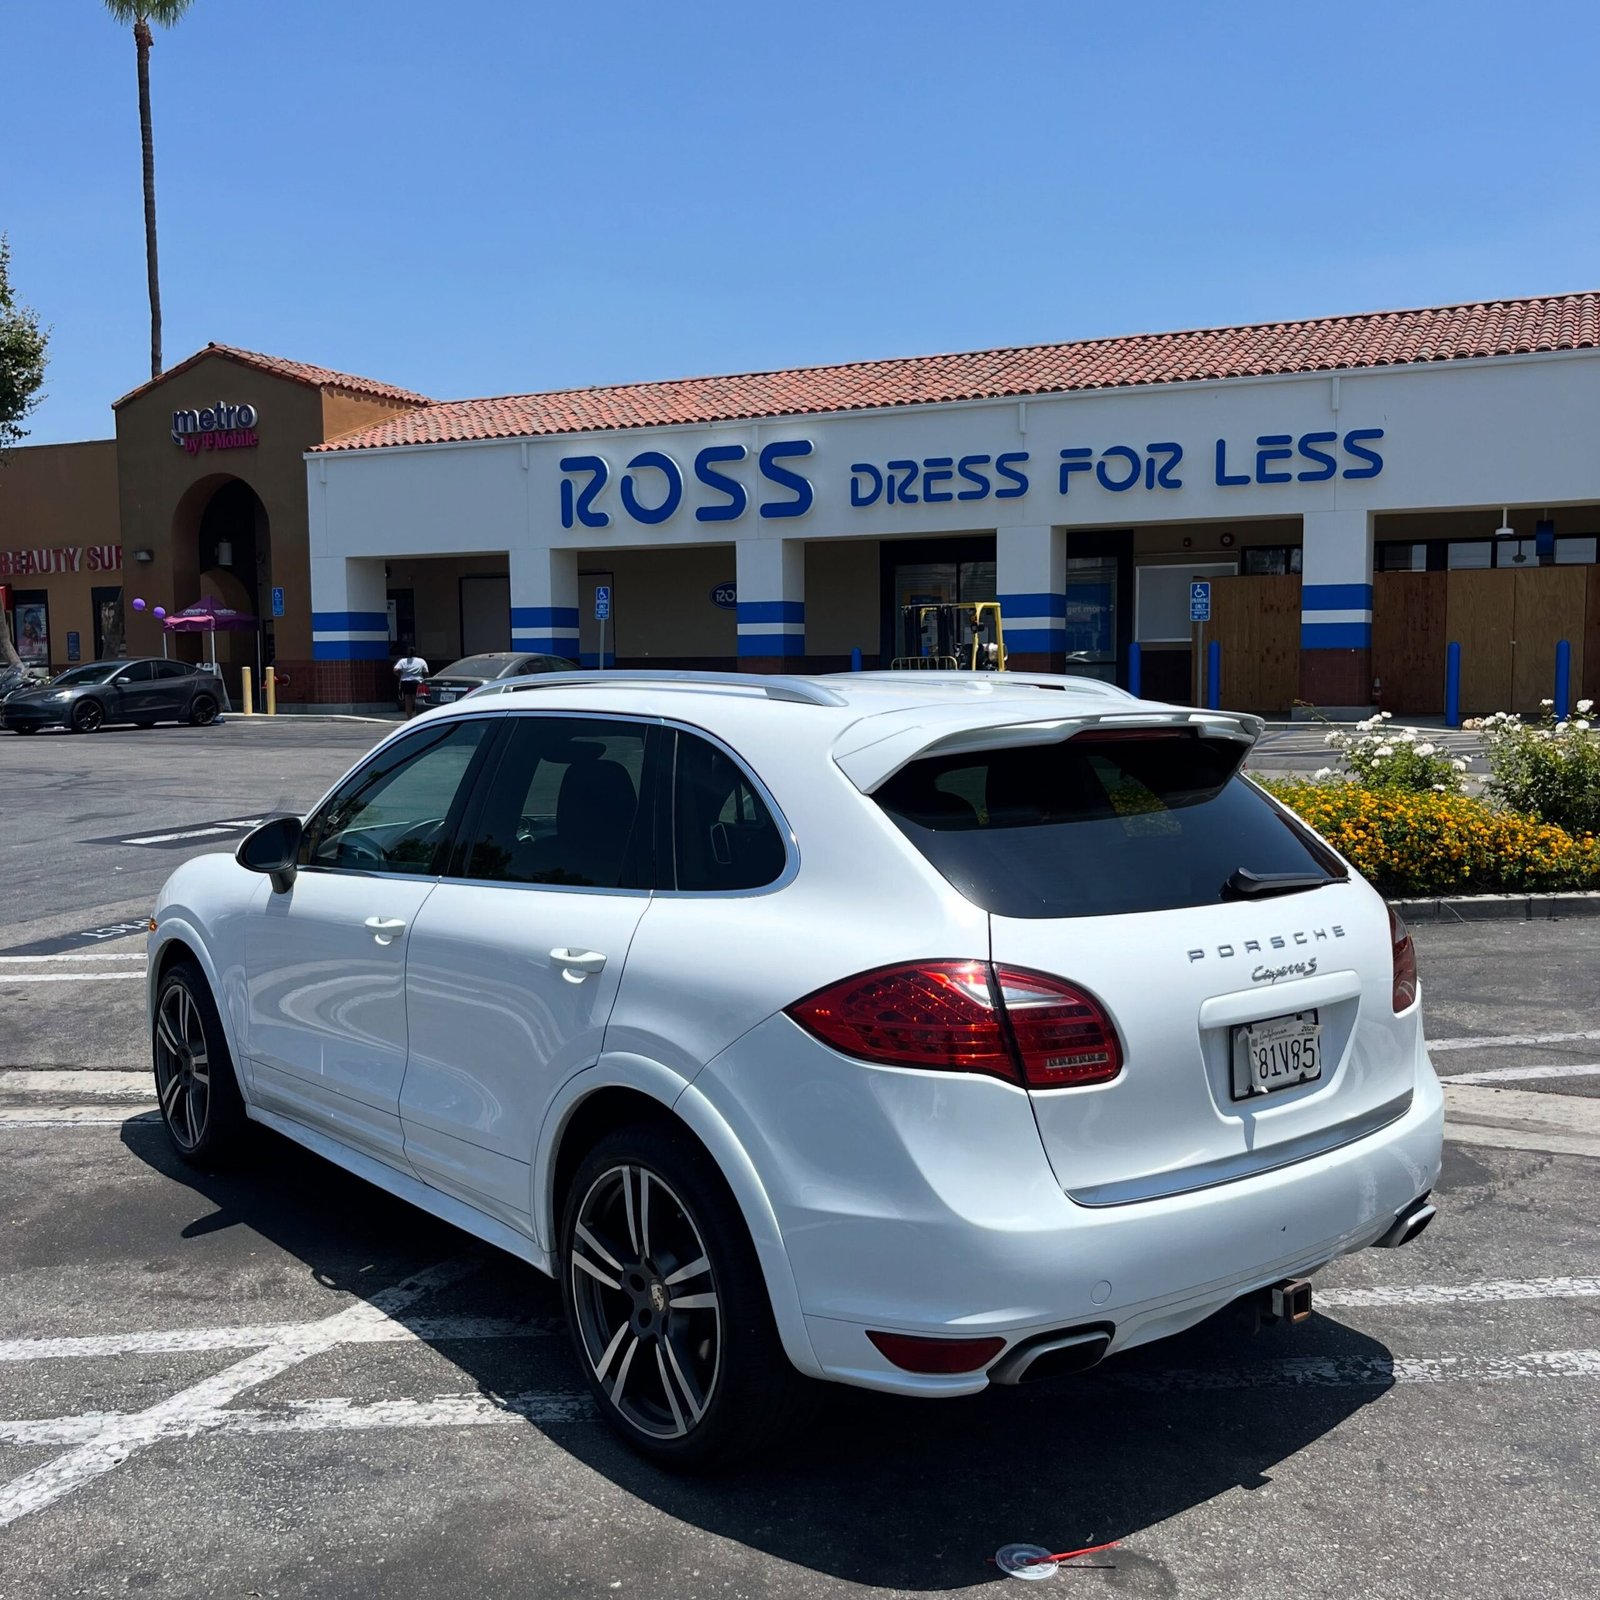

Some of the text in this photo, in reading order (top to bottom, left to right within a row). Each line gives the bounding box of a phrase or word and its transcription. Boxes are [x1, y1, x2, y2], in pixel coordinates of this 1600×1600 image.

[172, 400, 258, 432] metro
[184, 434, 200, 456] by
[560, 428, 1385, 529] ROSS DRESS FOR LESS
[0, 547, 83, 576] BEAUTY
[1187, 925, 1346, 963] PORSCHE
[1251, 956, 1318, 985] Cayenne S
[1253, 1037, 1316, 1080] 81V85
